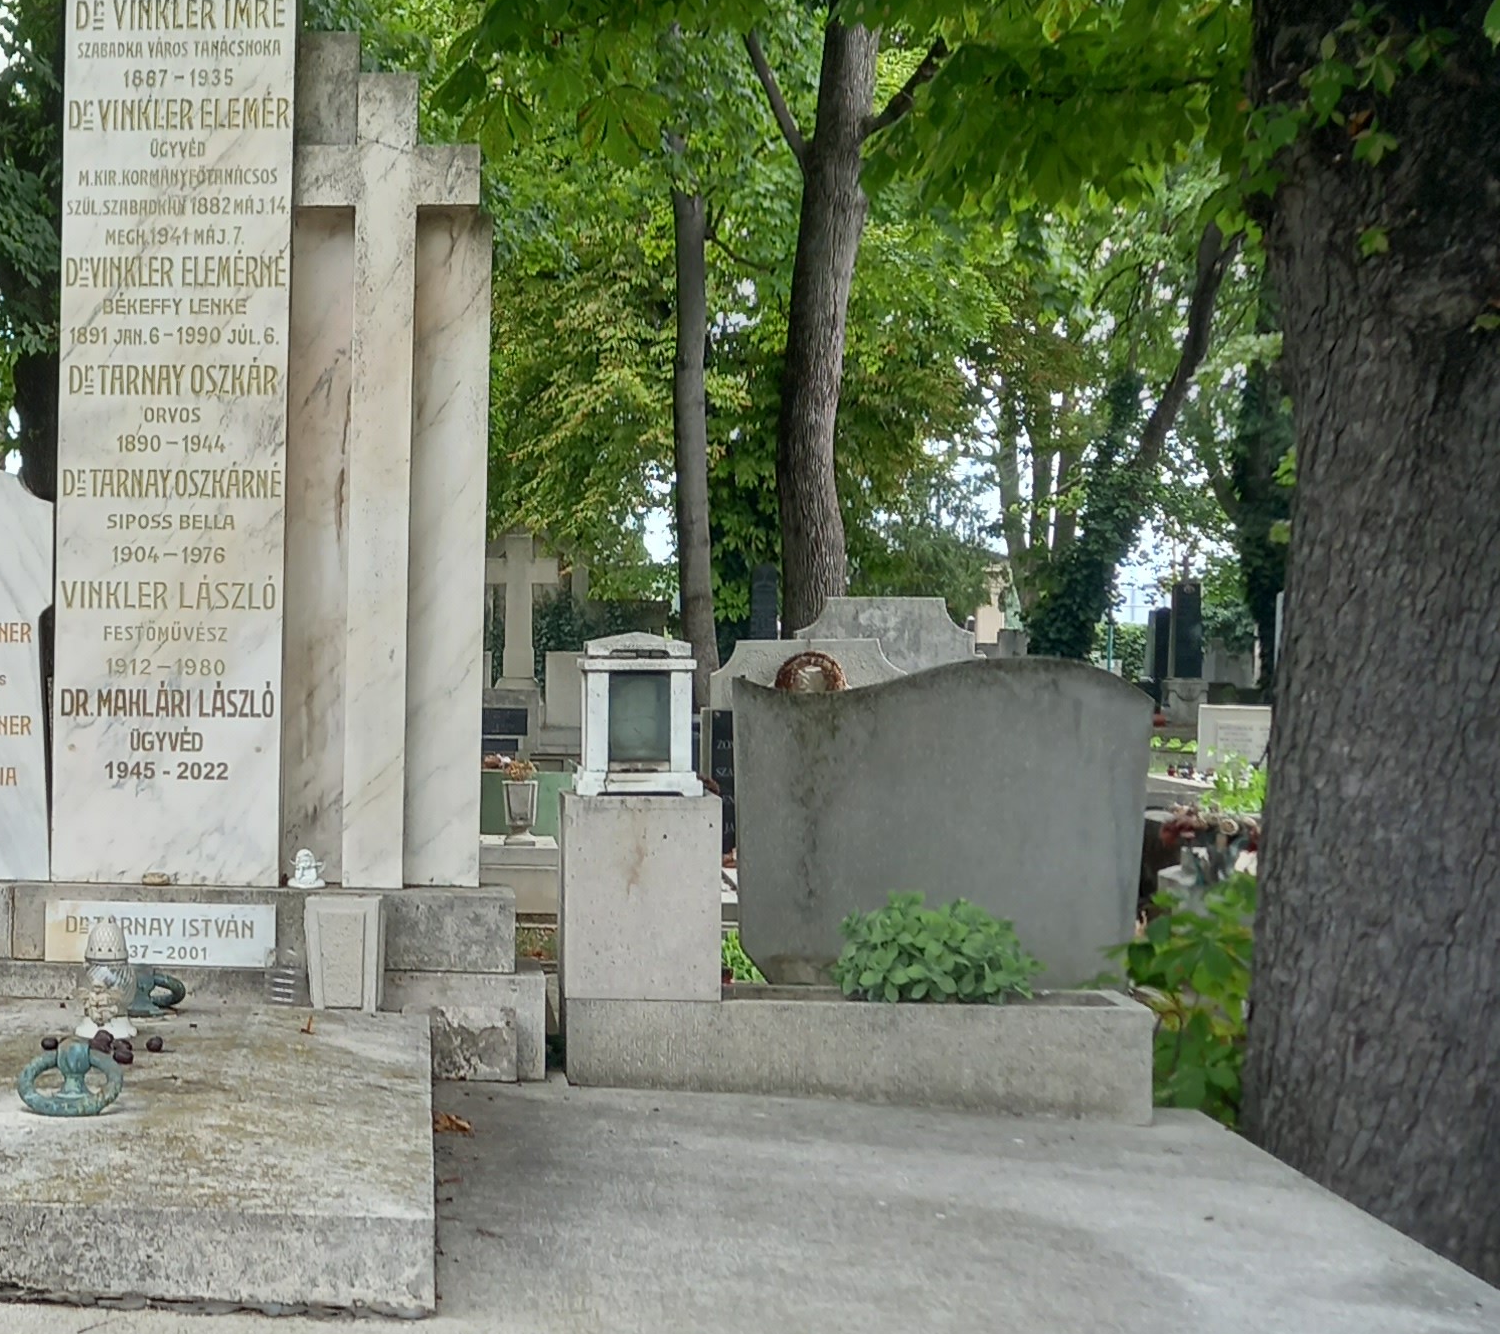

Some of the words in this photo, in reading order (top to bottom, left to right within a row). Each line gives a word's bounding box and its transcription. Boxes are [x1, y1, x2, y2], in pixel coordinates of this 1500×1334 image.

[77, 42, 143, 59] SZABADKA
[148, 36, 188, 59] VÁROS
[194, 35, 281, 57] TANÁCSNOKA
[190, 68, 233, 87] 1935
[98, 98, 194, 131] VINKLER
[201, 91, 290, 129] ELEMÉR
[150, 137, 206, 158] ÜGYVÉD
[191, 196, 230, 215] 1882
[90, 256, 173, 287] VINKLER
[182, 250, 286, 287] ELEMÉRNÉ
[103, 292, 182, 315] BÉKEFFY
[190, 298, 247, 315] LENKE
[70, 327, 107, 345] 1891
[177, 326, 221, 345] 1990
[97, 364, 186, 395] TARNAY
[190, 357, 278, 395] OSZKÁR
[143, 407, 201, 423] ORVOS
[117, 435, 161, 453] 1890
[182, 435, 226, 453] 1944
[89, 469, 172, 499] TARNAY
[175, 461, 282, 499] OSZKÁRNÉ
[106, 514, 172, 530] SIPOSS
[179, 514, 235, 530] BELLA
[112, 546, 159, 563] 1904
[182, 547, 226, 564] 1976
[61, 581, 168, 610] VINKLER
[179, 575, 276, 610] LÁSZLÓ
[106, 658, 151, 677] 1912
[175, 658, 225, 676] 1980
[97, 681, 191, 718] MAKLÁRI
[199, 681, 275, 718] LÁSZLÓ
[130, 727, 203, 752] ÜGYVÉD
[104, 761, 156, 780] 1945
[176, 762, 229, 781] 2022
[182, 914, 254, 939] ISTVÁN
[129, 945, 149, 959] 37
[166, 946, 207, 960] 2001
